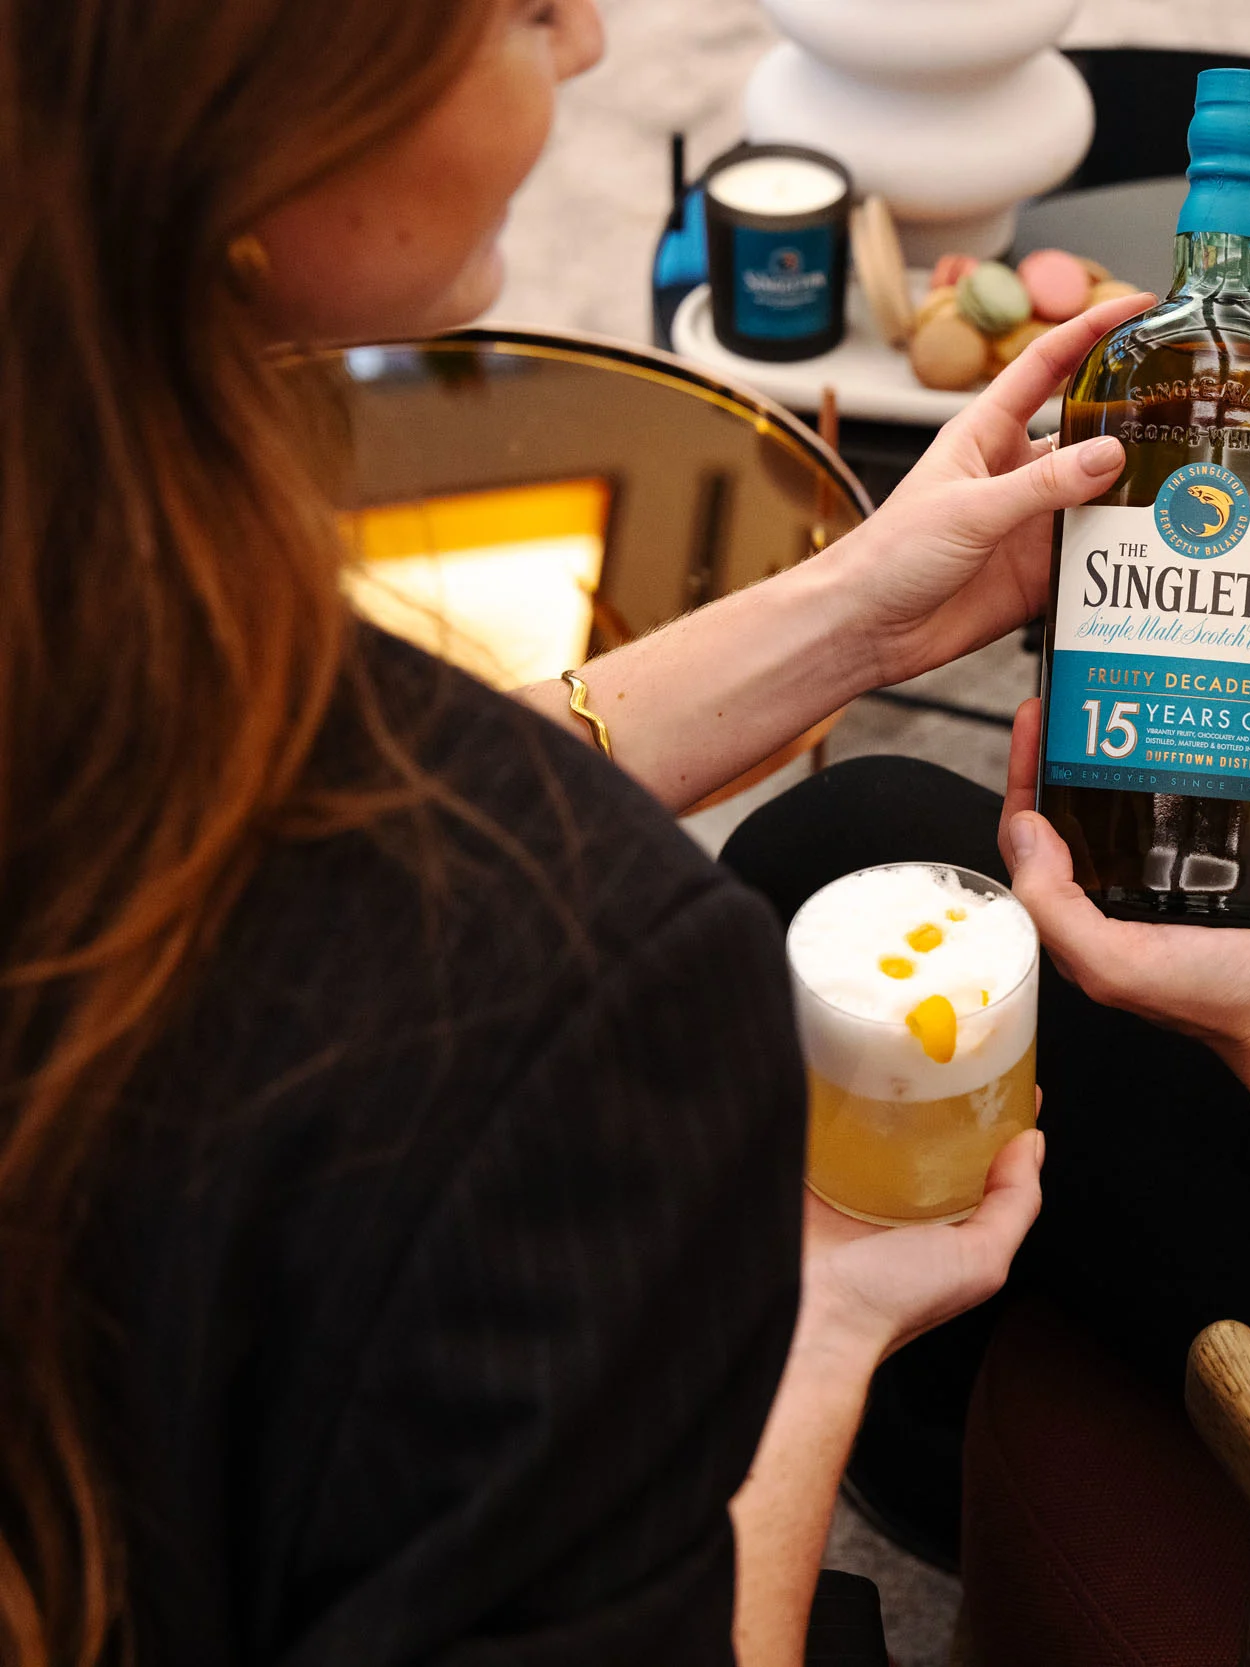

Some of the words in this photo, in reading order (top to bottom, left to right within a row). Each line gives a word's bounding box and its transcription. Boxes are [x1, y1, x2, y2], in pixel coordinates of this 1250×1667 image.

[1119, 420, 1201, 447] SCOTCH
[1167, 472, 1186, 491] THE
[1189, 465, 1245, 497] SINGLETON
[1160, 509, 1200, 555] PERFECTLY
[1205, 515, 1248, 556] BALANCED
[1119, 542, 1148, 558] THE
[1075, 609, 1136, 645] Single
[1132, 615, 1181, 642] Malt
[1181, 617, 1247, 648] Scotch
[1088, 667, 1155, 686] FRUITY
[1081, 699, 1141, 759] 15
[1146, 703, 1231, 729] YEARS
[1146, 727, 1176, 736] VIBRANTLY
[1197, 732, 1235, 741] CHOCOLATEY
[1236, 735, 1250, 743] AND
[1178, 739, 1209, 748] MATURED
[1216, 743, 1244, 752] BOTTLED
[1146, 750, 1214, 766] DUFFTOWN
[1082, 770, 1157, 784] ENJOYED
[1170, 777, 1225, 790] SINCE
